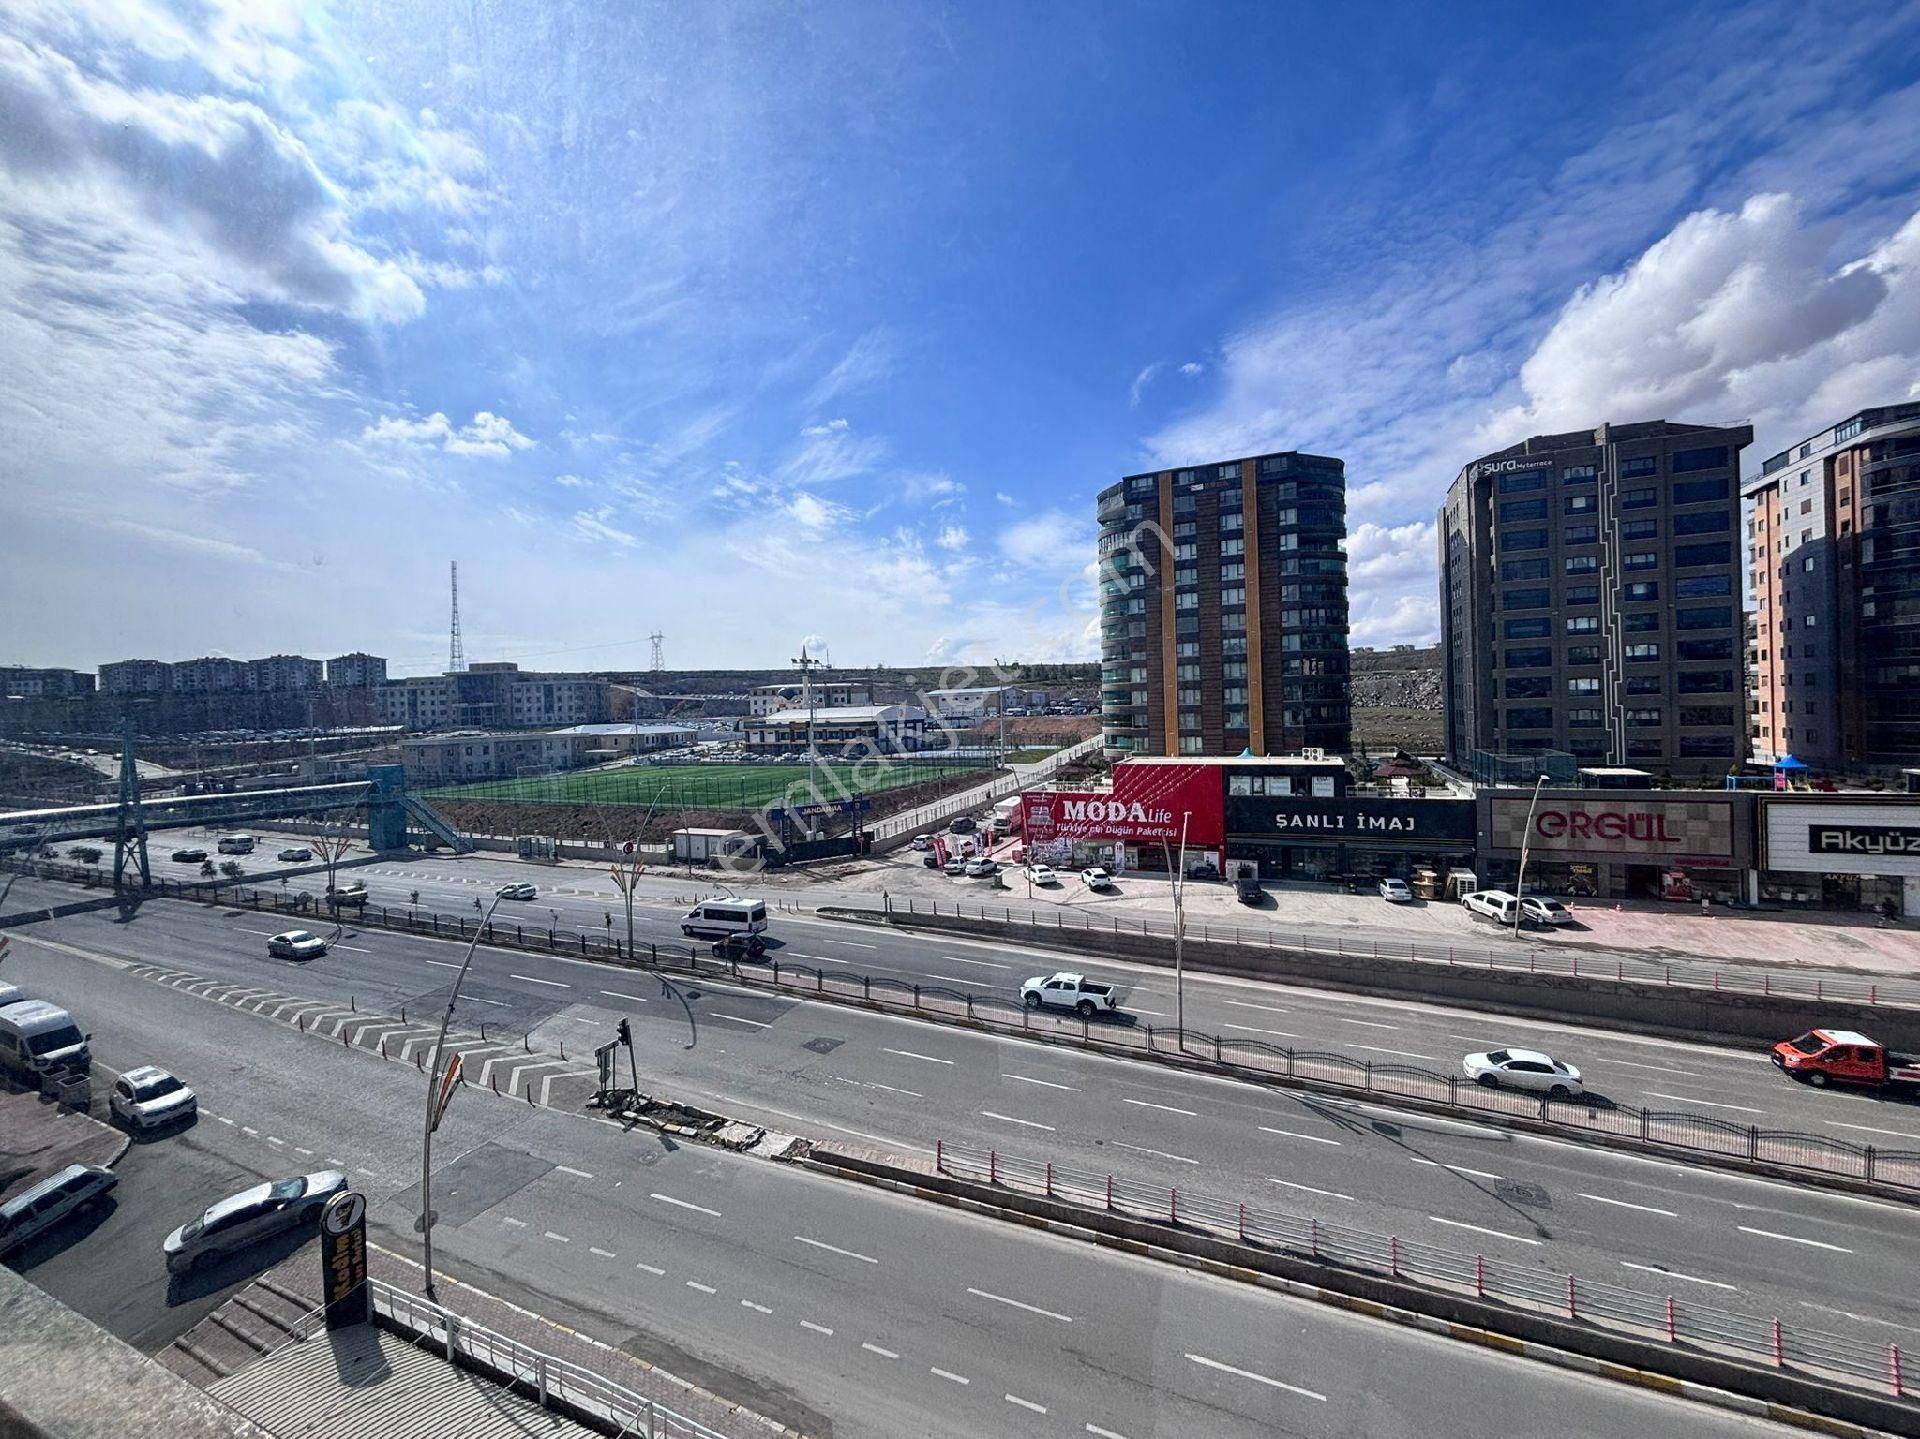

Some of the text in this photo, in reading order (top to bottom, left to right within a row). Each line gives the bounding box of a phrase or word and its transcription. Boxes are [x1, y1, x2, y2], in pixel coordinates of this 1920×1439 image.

[1063, 800, 1172, 824] MODA Life
[1276, 812, 1415, 831] ŞANLI İMAJ
[1106, 825, 1133, 836] Düğün
[1137, 827, 1177, 837] Paketisi
